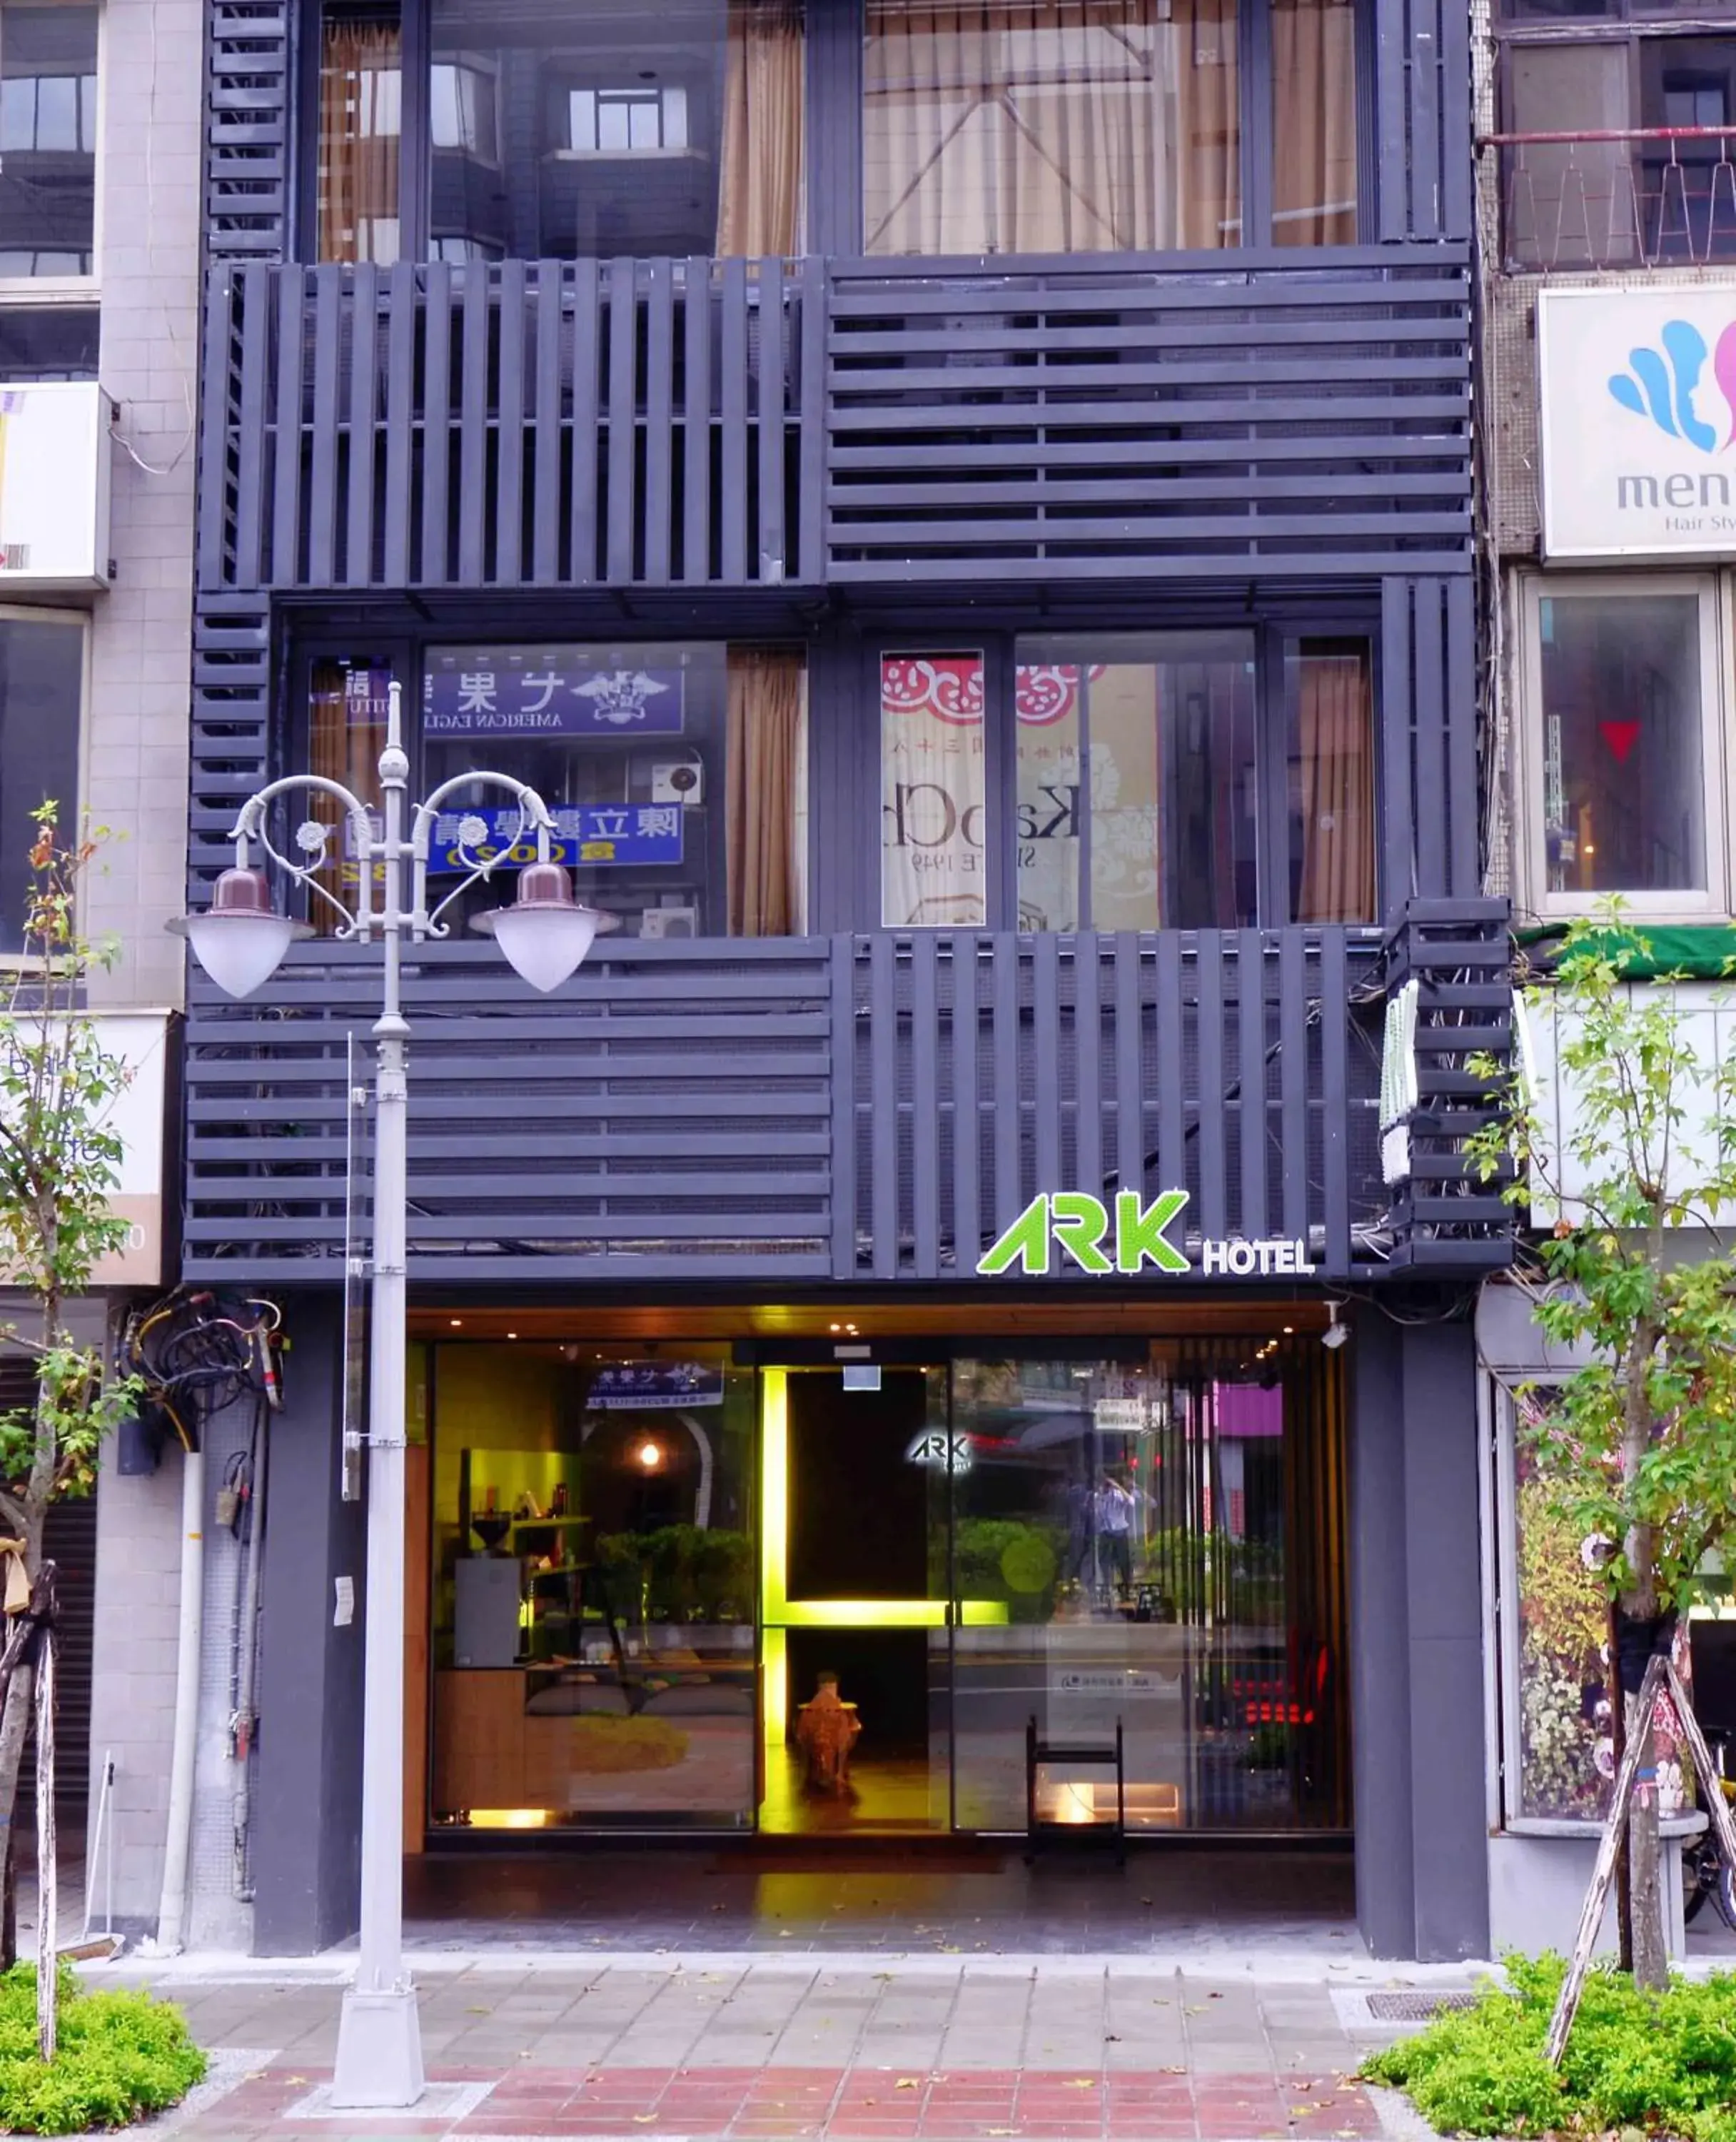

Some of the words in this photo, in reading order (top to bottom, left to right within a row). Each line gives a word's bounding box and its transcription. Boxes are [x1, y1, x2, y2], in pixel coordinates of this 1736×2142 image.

[1618, 473, 1736, 509] men
[1665, 517, 1703, 531] Hair
[976, 1190, 1191, 1274] ARK
[1203, 1240, 1316, 1275] HOTEL
[912, 1436, 967, 1459] ARK
